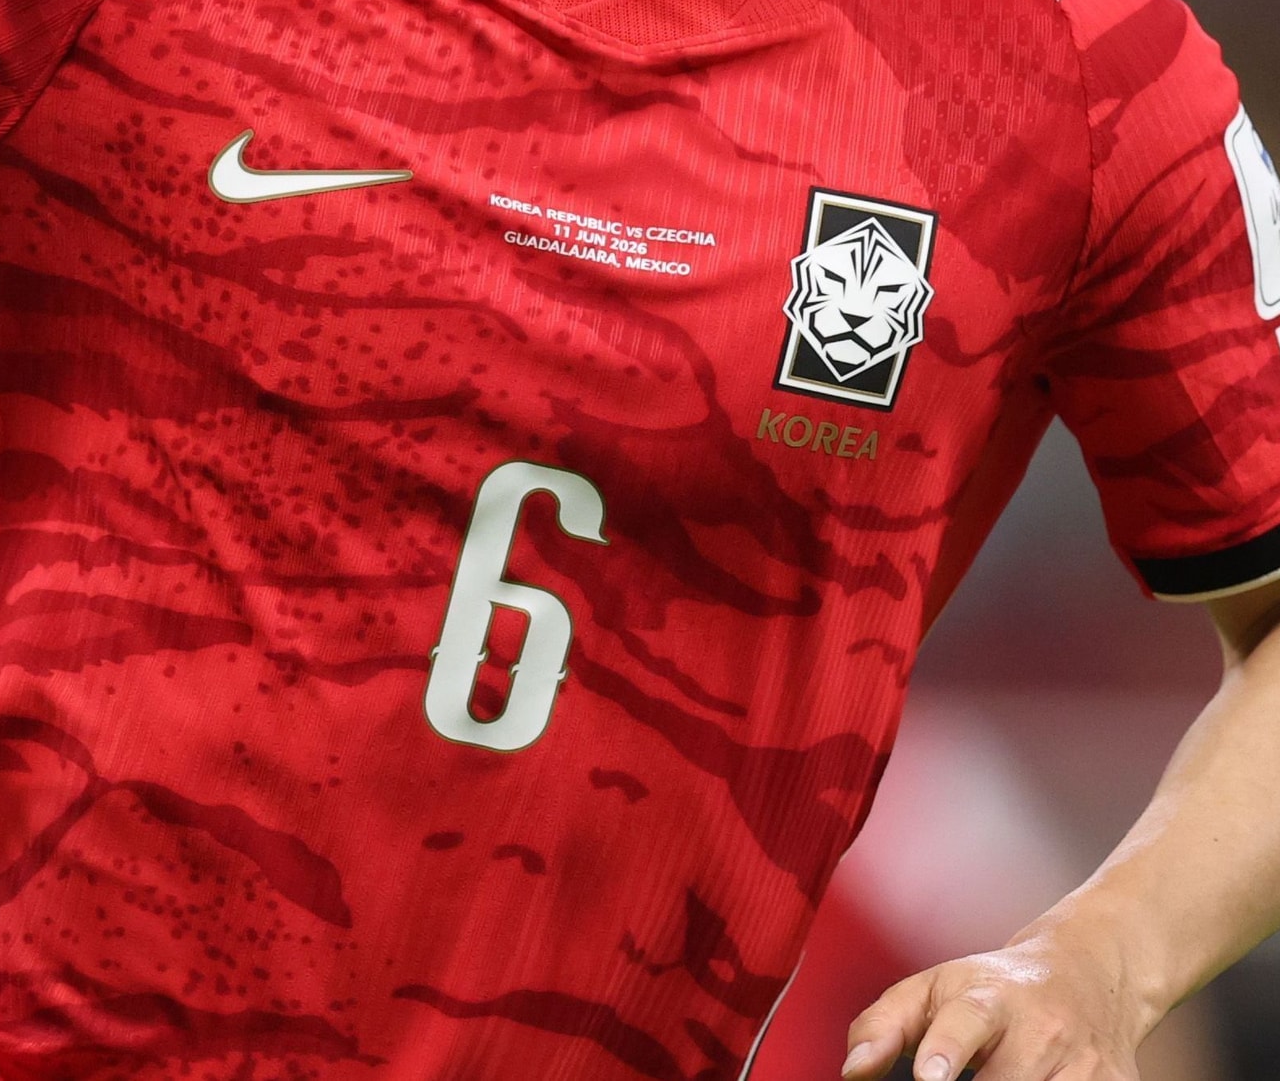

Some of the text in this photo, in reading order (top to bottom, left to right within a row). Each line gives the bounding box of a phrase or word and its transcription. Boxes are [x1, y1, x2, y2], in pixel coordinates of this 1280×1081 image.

[490, 193, 542, 217] KOREA
[547, 209, 622, 235] REPUBLIC
[646, 226, 716, 246] CZECHIA
[553, 224, 647, 254] 11 JUN 2026
[504, 230, 690, 275] GUADALAJARA, MEXICO
[757, 408, 879, 460] KOREA
[423, 458, 611, 753] 6
